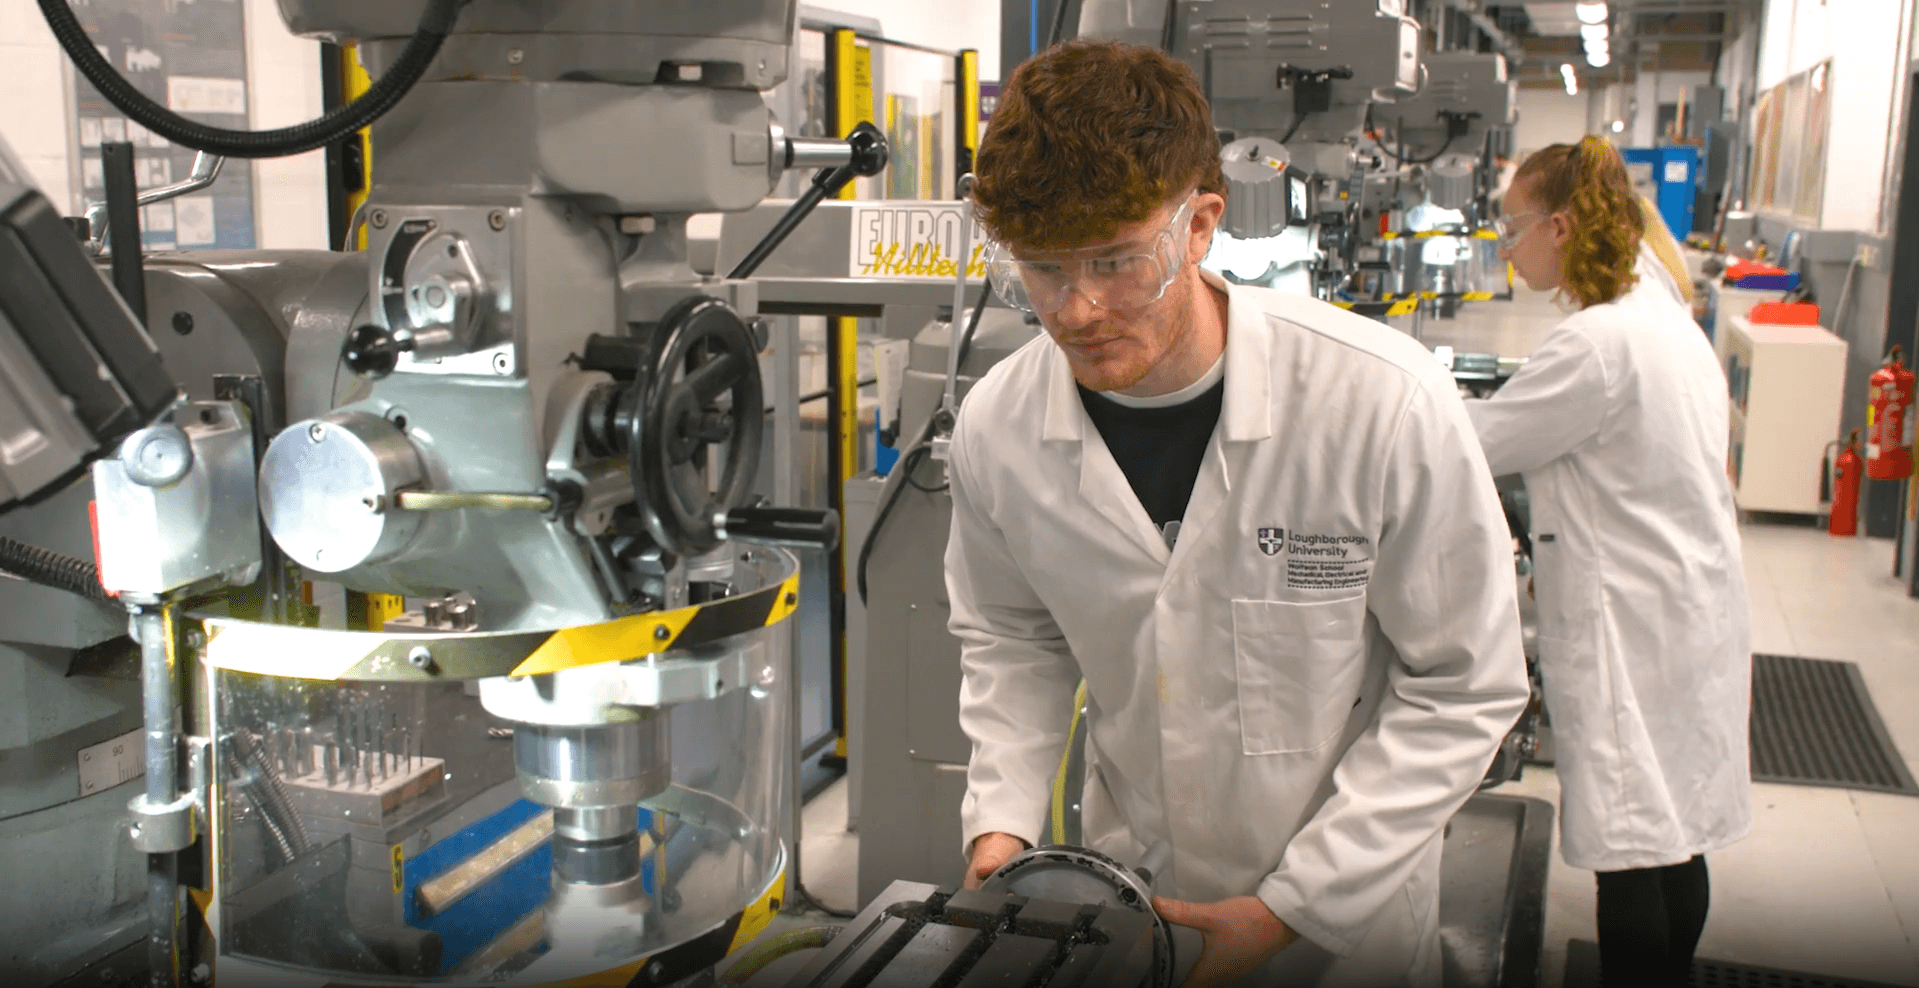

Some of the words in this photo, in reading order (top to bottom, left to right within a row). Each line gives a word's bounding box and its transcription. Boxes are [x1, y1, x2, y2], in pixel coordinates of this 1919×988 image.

[1288, 529, 1369, 545] Loughborough
[1288, 543, 1348, 558] University
[1288, 563, 1317, 571] Wolfson
[1288, 577, 1333, 586] Manufacturing
[112, 745, 124, 756] 90
